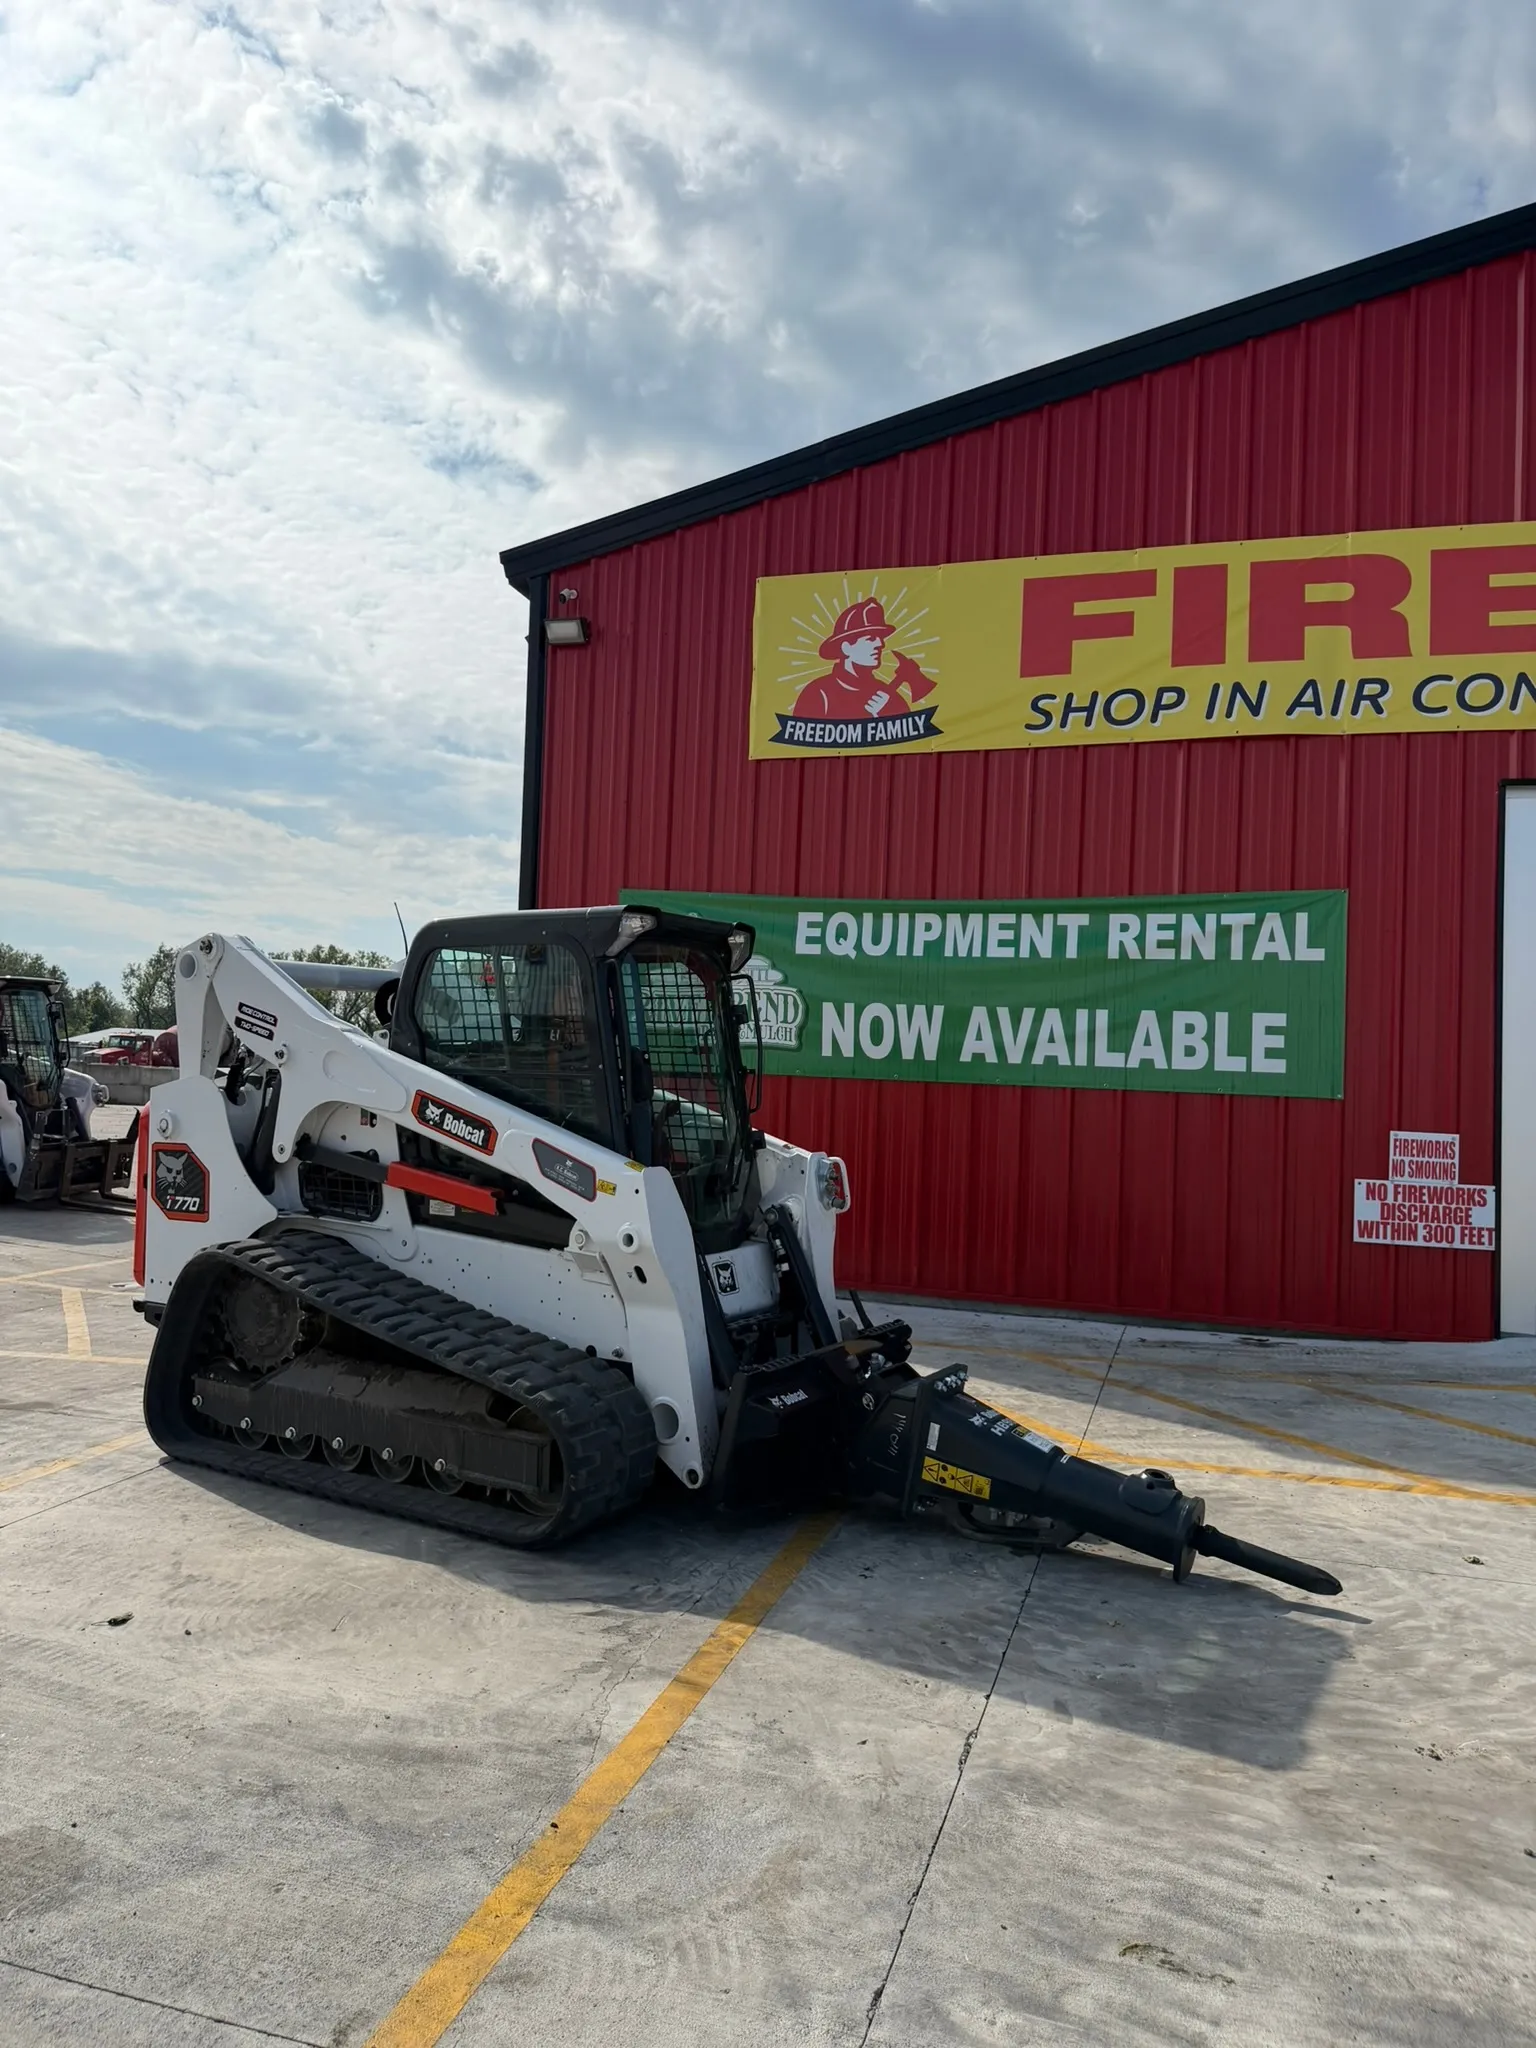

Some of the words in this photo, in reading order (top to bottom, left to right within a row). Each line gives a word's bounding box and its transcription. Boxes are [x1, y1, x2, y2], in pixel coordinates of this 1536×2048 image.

[1019, 543, 1536, 679] FIRE
[1023, 685, 1187, 733] SHOP
[1204, 680, 1269, 723] IN
[1283, 677, 1392, 719] AIR
[784, 720, 862, 744] FREEDOM
[866, 714, 926, 742] FAMILY
[795, 911, 1090, 960] EQUIPMENT
[1107, 912, 1326, 962] RENTAL
[821, 1002, 945, 1061] NOW
[959, 1006, 1288, 1074] AVAILABLE
[443, 1112, 485, 1146] Bobcat
[1393, 1138, 1456, 1160] FIREWORKS
[1391, 1158, 1406, 1178] NO
[1408, 1159, 1457, 1181] SMOKING
[1365, 1182, 1388, 1201] NO
[1393, 1184, 1487, 1208] FIREWORKS
[1380, 1202, 1473, 1226] DISCHARGE
[1357, 1219, 1418, 1242] WITHIN
[1422, 1224, 1456, 1244] 300
[1459, 1226, 1496, 1247] FEET
